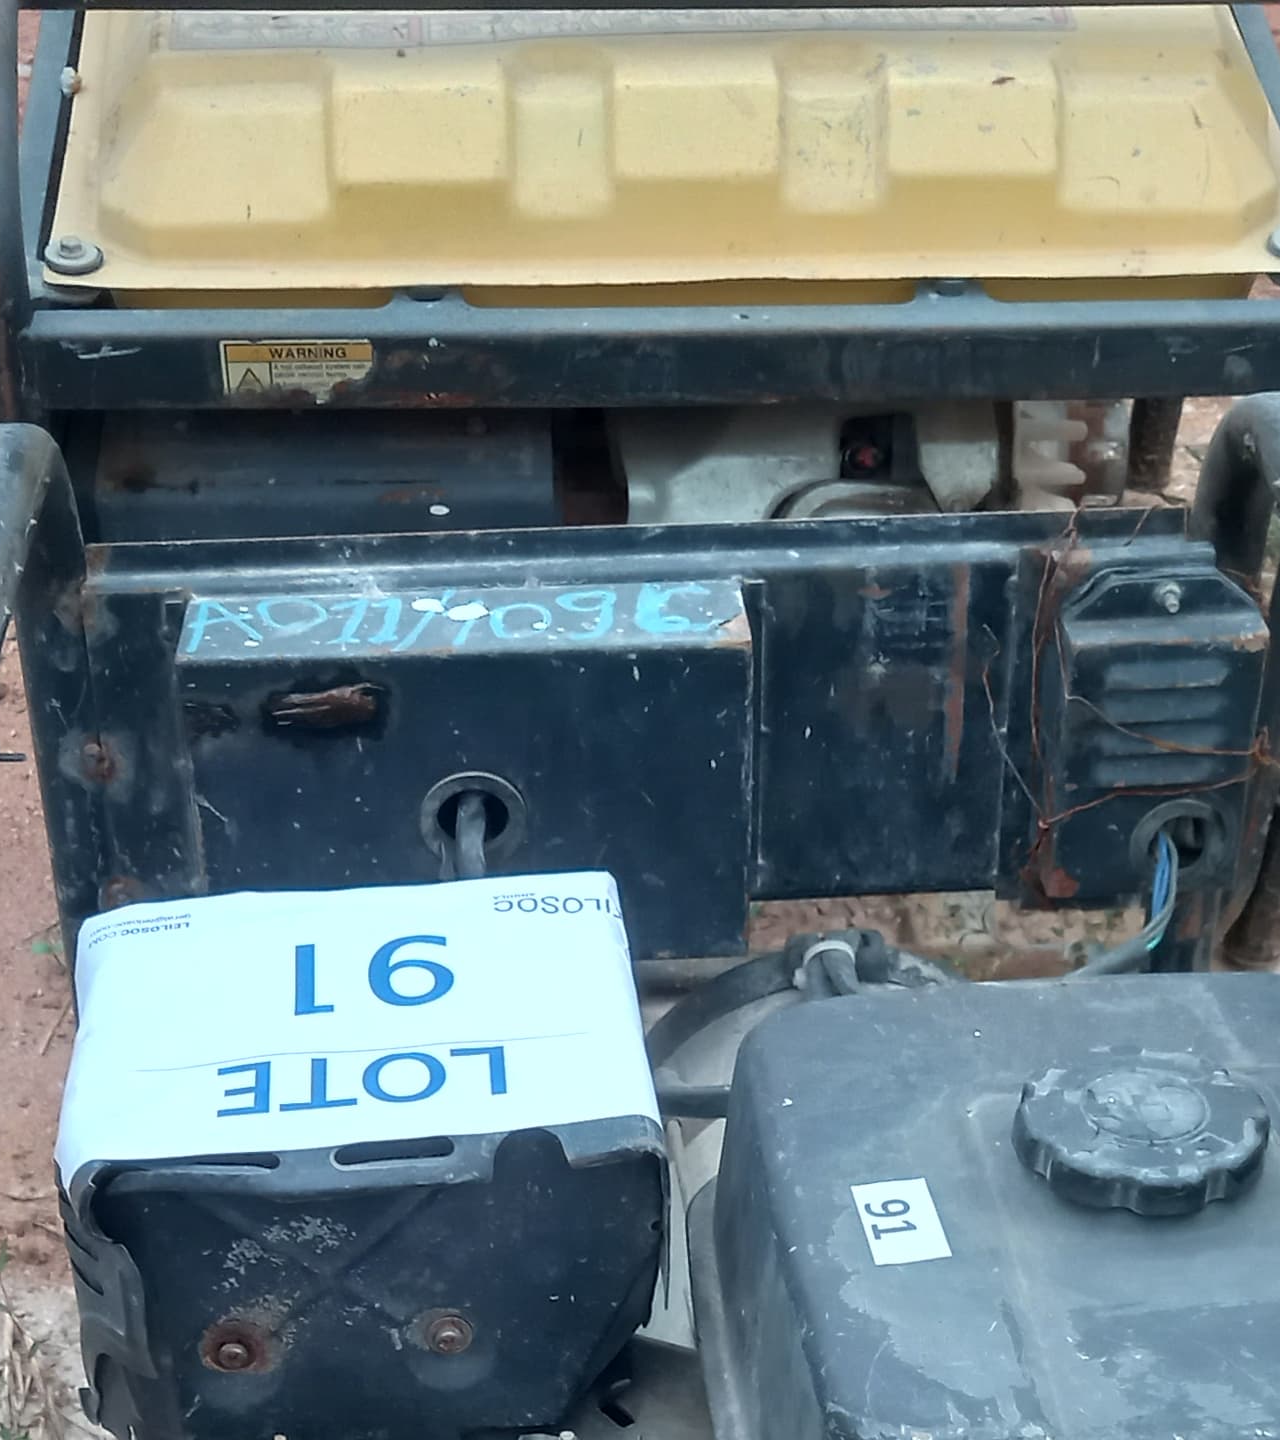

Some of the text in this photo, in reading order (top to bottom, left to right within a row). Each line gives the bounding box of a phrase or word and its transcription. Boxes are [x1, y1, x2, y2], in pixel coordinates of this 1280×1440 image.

[268, 346, 347, 360] WARNING
[293, 934, 455, 1017] 91
[216, 1045, 508, 1118] LOTE
[864, 1198, 918, 1241] 91
